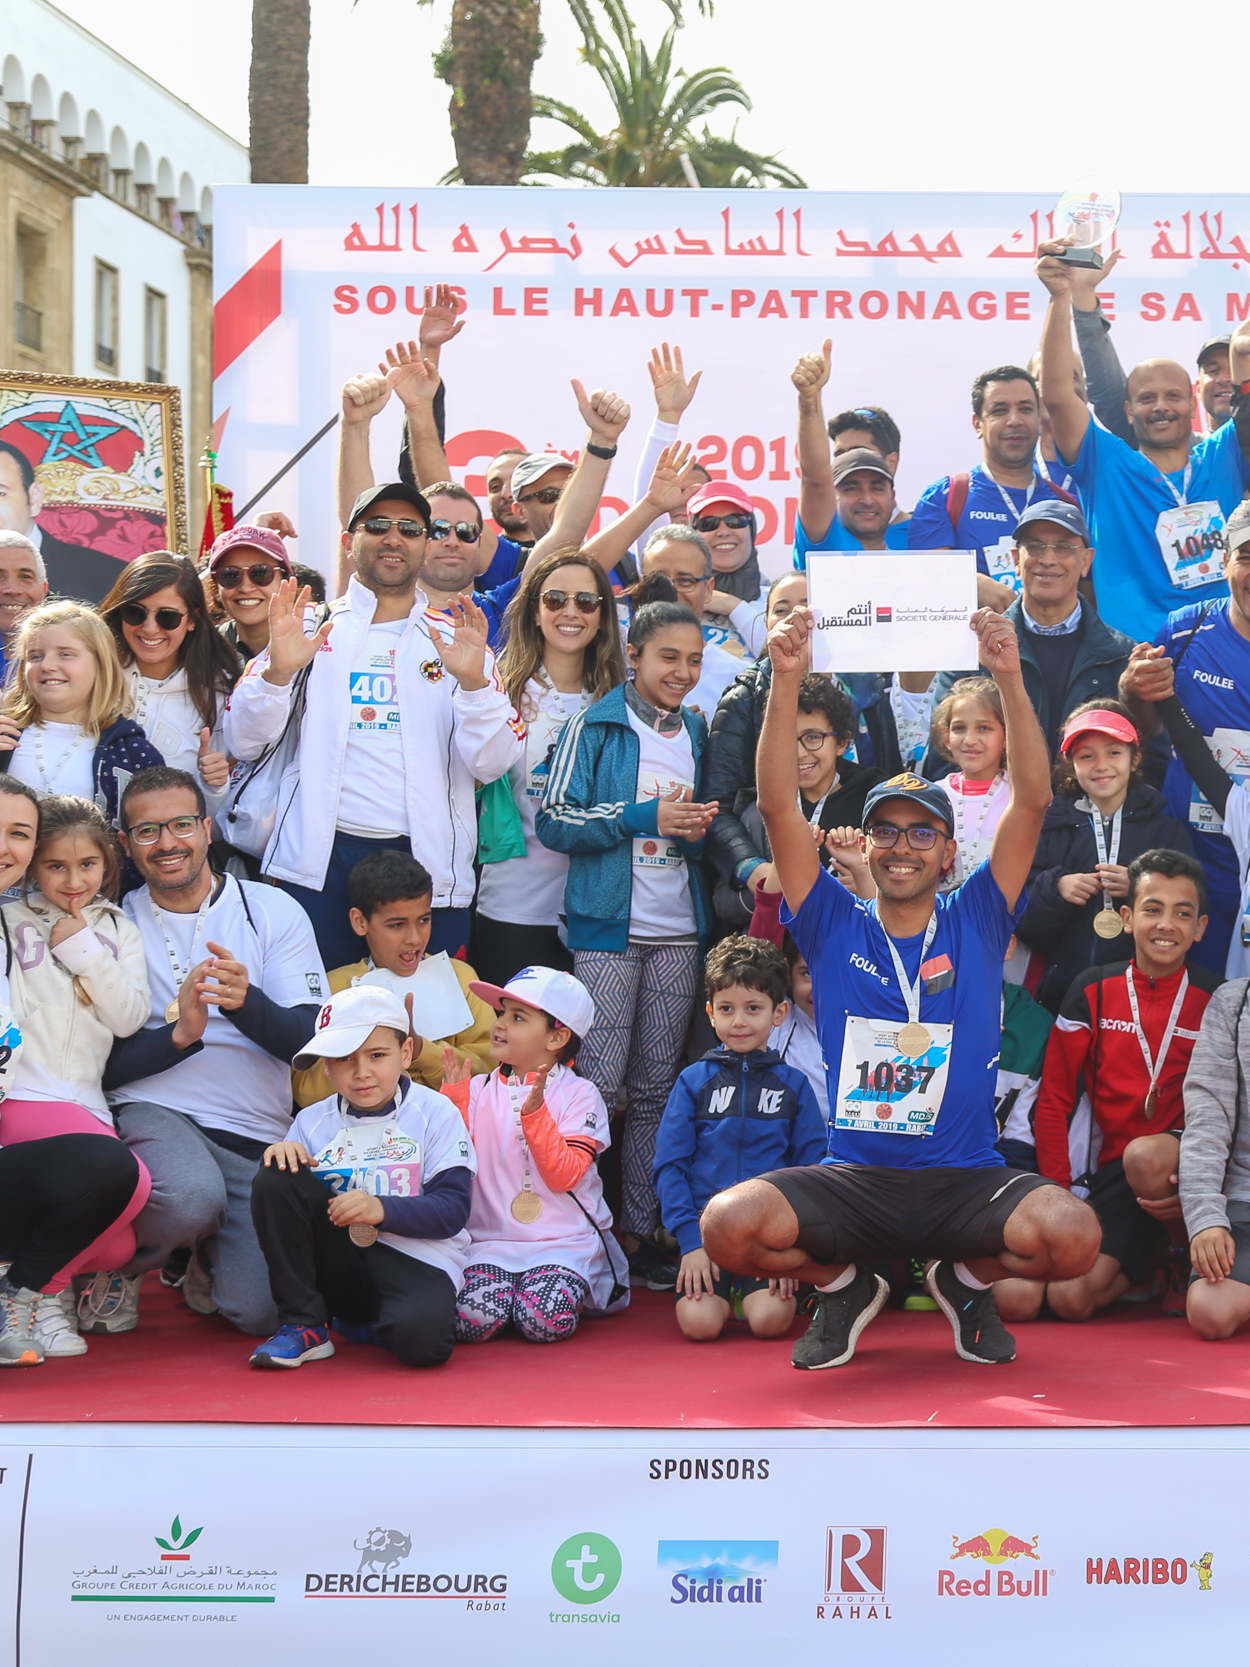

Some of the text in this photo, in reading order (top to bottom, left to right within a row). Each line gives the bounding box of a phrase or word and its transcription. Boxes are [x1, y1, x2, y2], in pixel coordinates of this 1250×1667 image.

[343, 202, 430, 253] الله
[607, 206, 813, 269] السادس
[451, 220, 584, 272] نصره
[836, 227, 964, 265] محمد
[492, 286, 549, 317] LE
[574, 287, 1031, 321] HAUT-PATRONAGE
[1140, 292, 1203, 321] SA
[1171, 529, 1225, 561] 1048
[847, 600, 872, 615] أنتم
[817, 614, 873, 630] المستقبل
[896, 614, 969, 622] SOCIETE GENERALE
[1193, 670, 1235, 690] FOULEE
[1203, 823, 1223, 831] AVRIL
[318, 1004, 333, 1029] B
[1100, 1018, 1137, 1034] acron
[855, 1061, 936, 1094] 1037
[846, 1119, 853, 1128] 7
[853, 1120, 877, 1129] AVRIL
[878, 1122, 898, 1131] 2019
[909, 1111, 934, 1122] MDJS
[649, 1458, 770, 1480] SPONSORS
[226, 1564, 278, 1579] مجموعة
[1086, 1557, 1188, 1585] HARIBO
[304, 1573, 508, 1593] DERICHEBOURG
[670, 1572, 763, 1605] Sidi ali
[937, 1569, 1048, 1597] Red Bull
[466, 1600, 507, 1612] Rabat
[817, 1605, 893, 1620] RAHAL
[107, 1614, 238, 1622] UN ENGAGEMENT DURABLE
[548, 1611, 621, 1624] transavia
